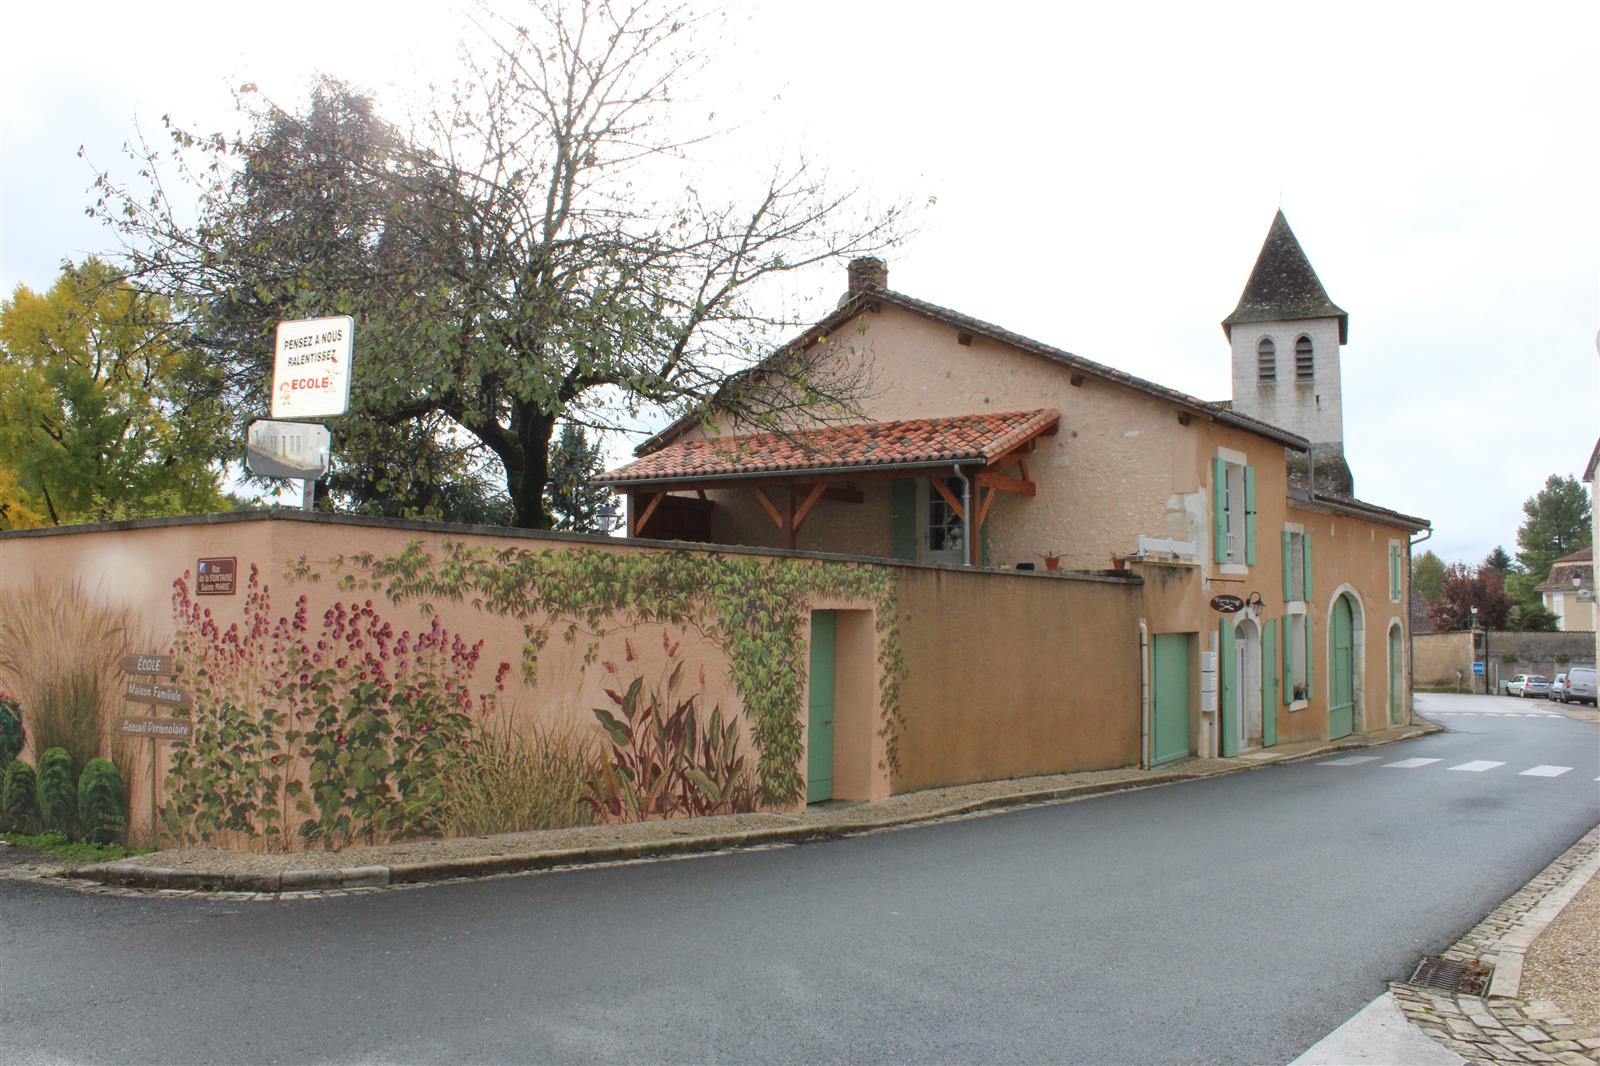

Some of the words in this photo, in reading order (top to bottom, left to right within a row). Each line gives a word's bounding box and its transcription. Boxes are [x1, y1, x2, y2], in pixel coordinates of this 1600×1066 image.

[284, 336, 312, 350] PENSEZ
[322, 329, 342, 344] NOUS
[288, 349, 336, 367] RALENTISSEZ
[291, 377, 329, 390] ECOLE
[210, 573, 233, 582] FONTAINE
[215, 582, 230, 591] MARIE
[137, 656, 161, 671] ÉCOLE
[128, 683, 151, 697] Maison
[153, 686, 181, 702] Familiale
[123, 720, 147, 732] Accueil
